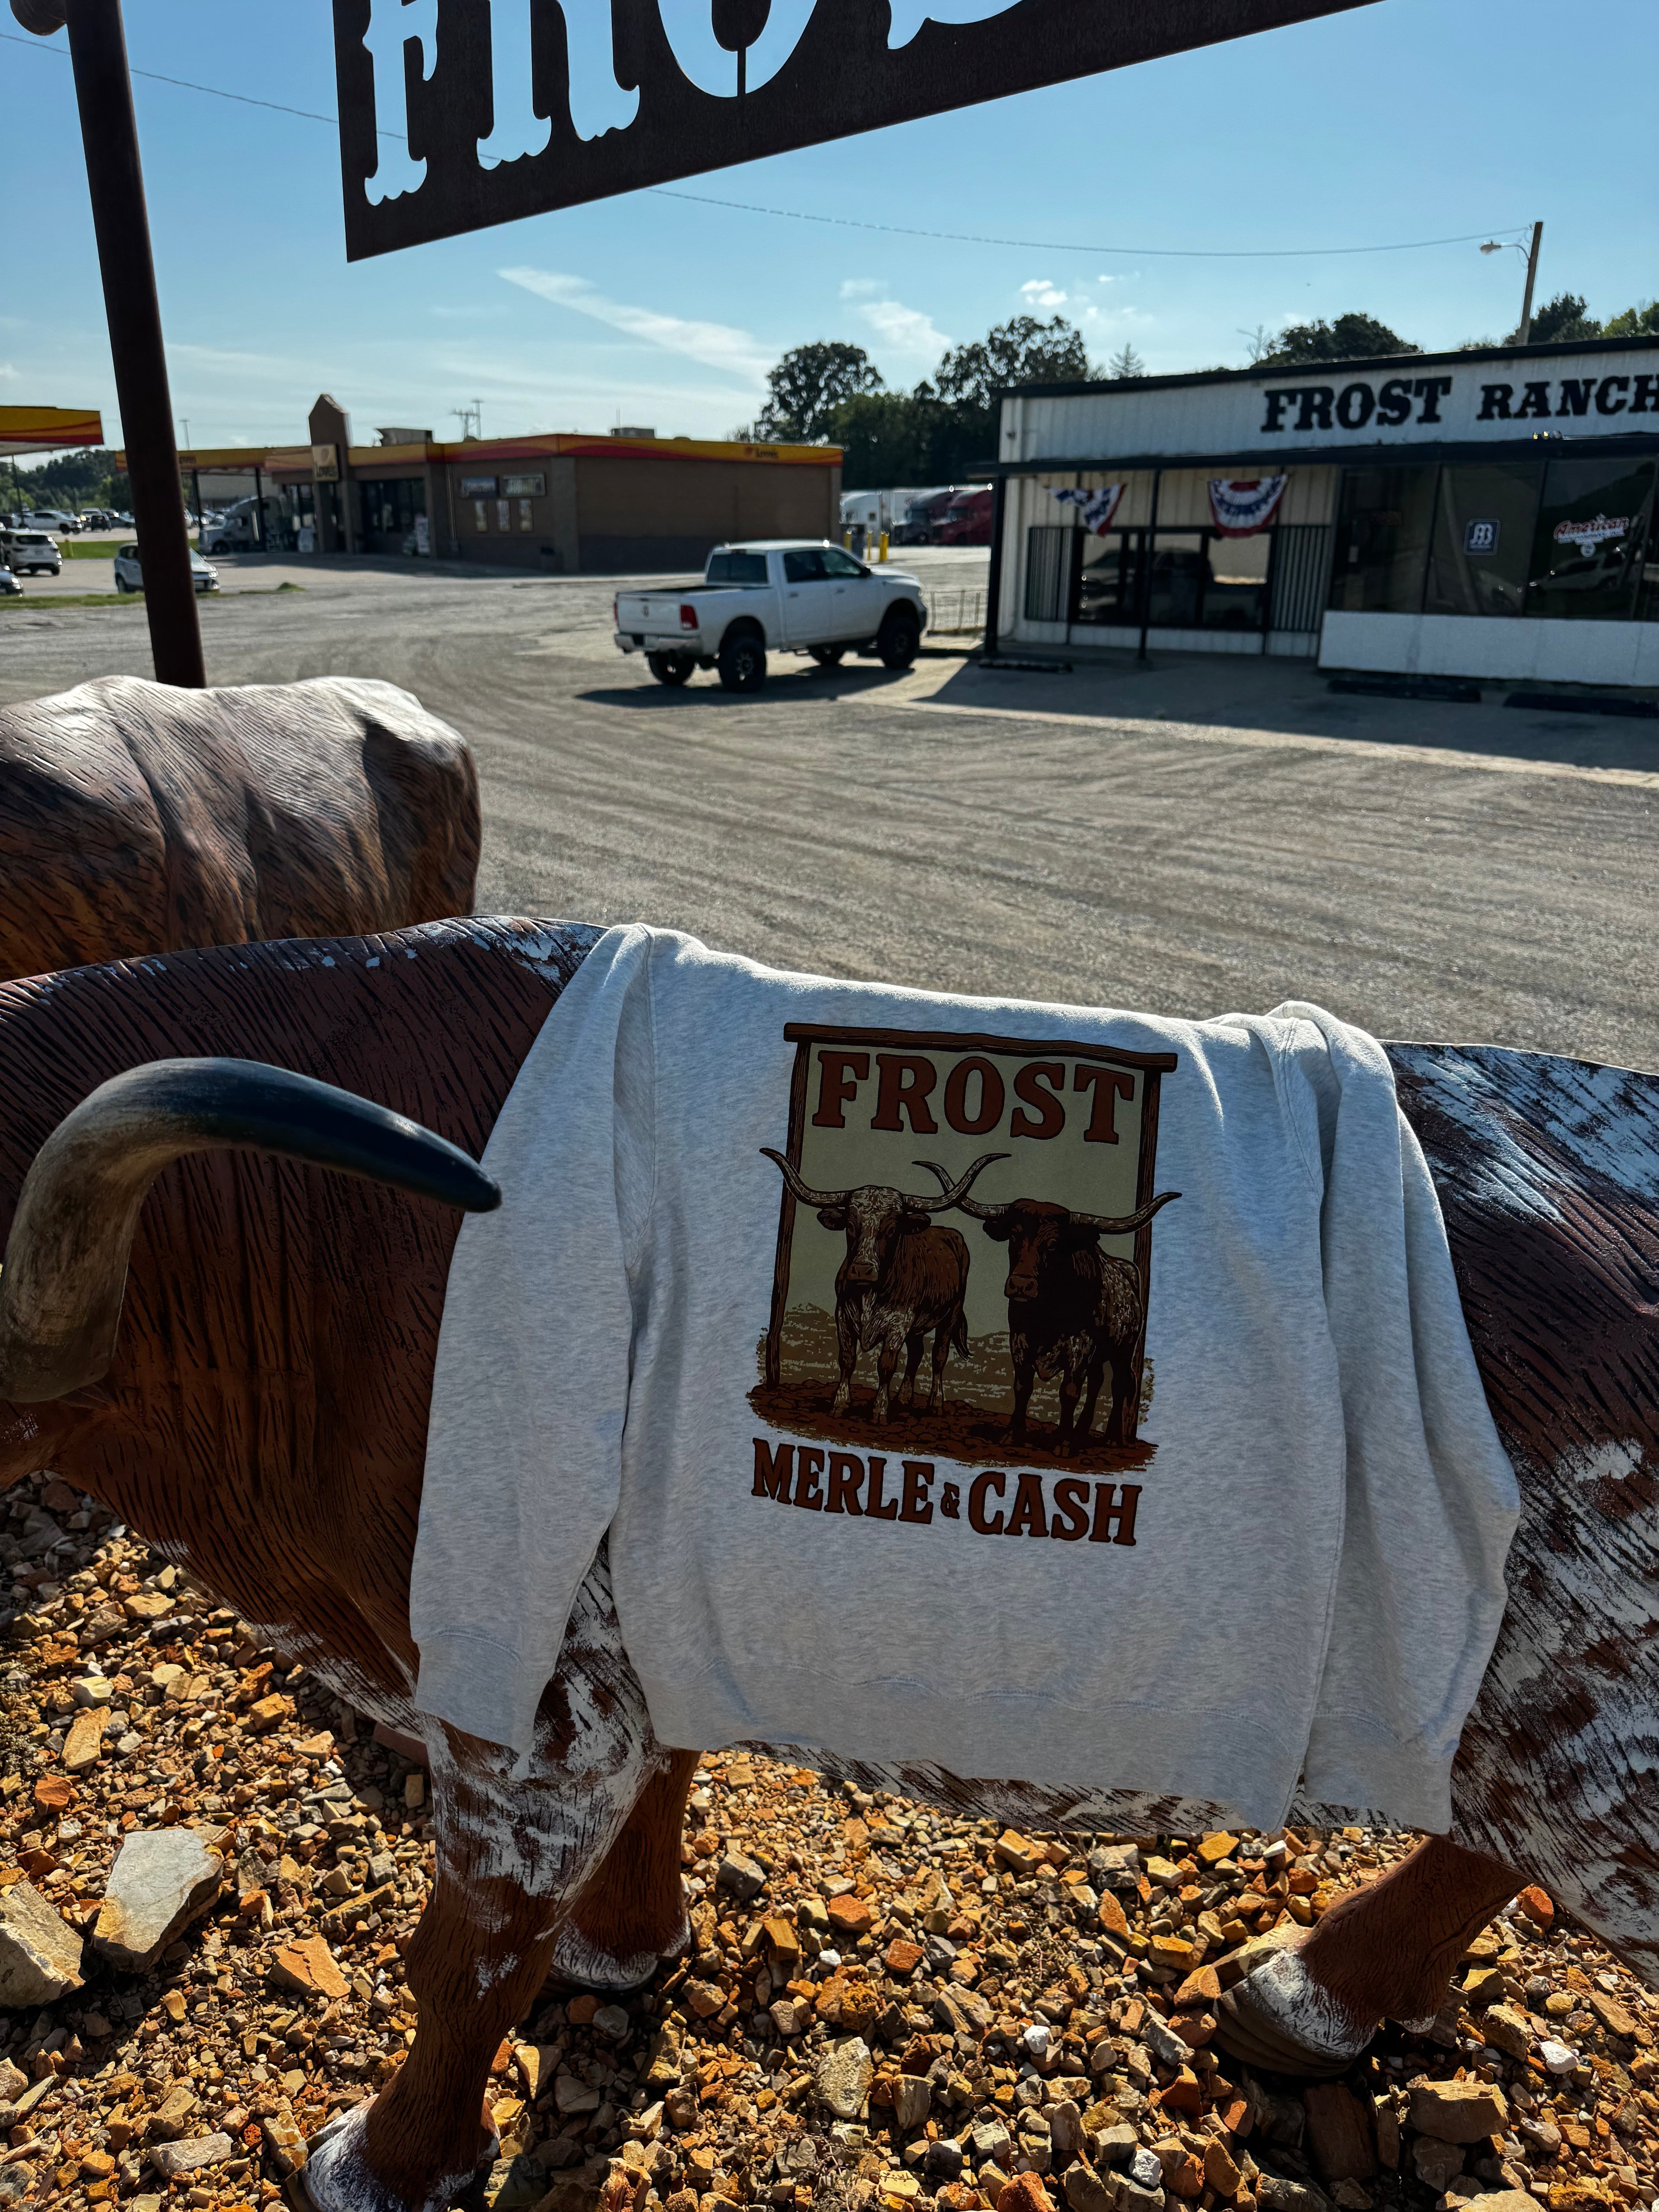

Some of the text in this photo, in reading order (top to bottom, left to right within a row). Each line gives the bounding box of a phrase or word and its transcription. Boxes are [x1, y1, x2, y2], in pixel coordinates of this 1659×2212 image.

[1260, 374, 1659, 432] FROST RANCH
[812, 1050, 1135, 1145] FROST
[751, 1437, 1143, 1546] MERLE & CASH
